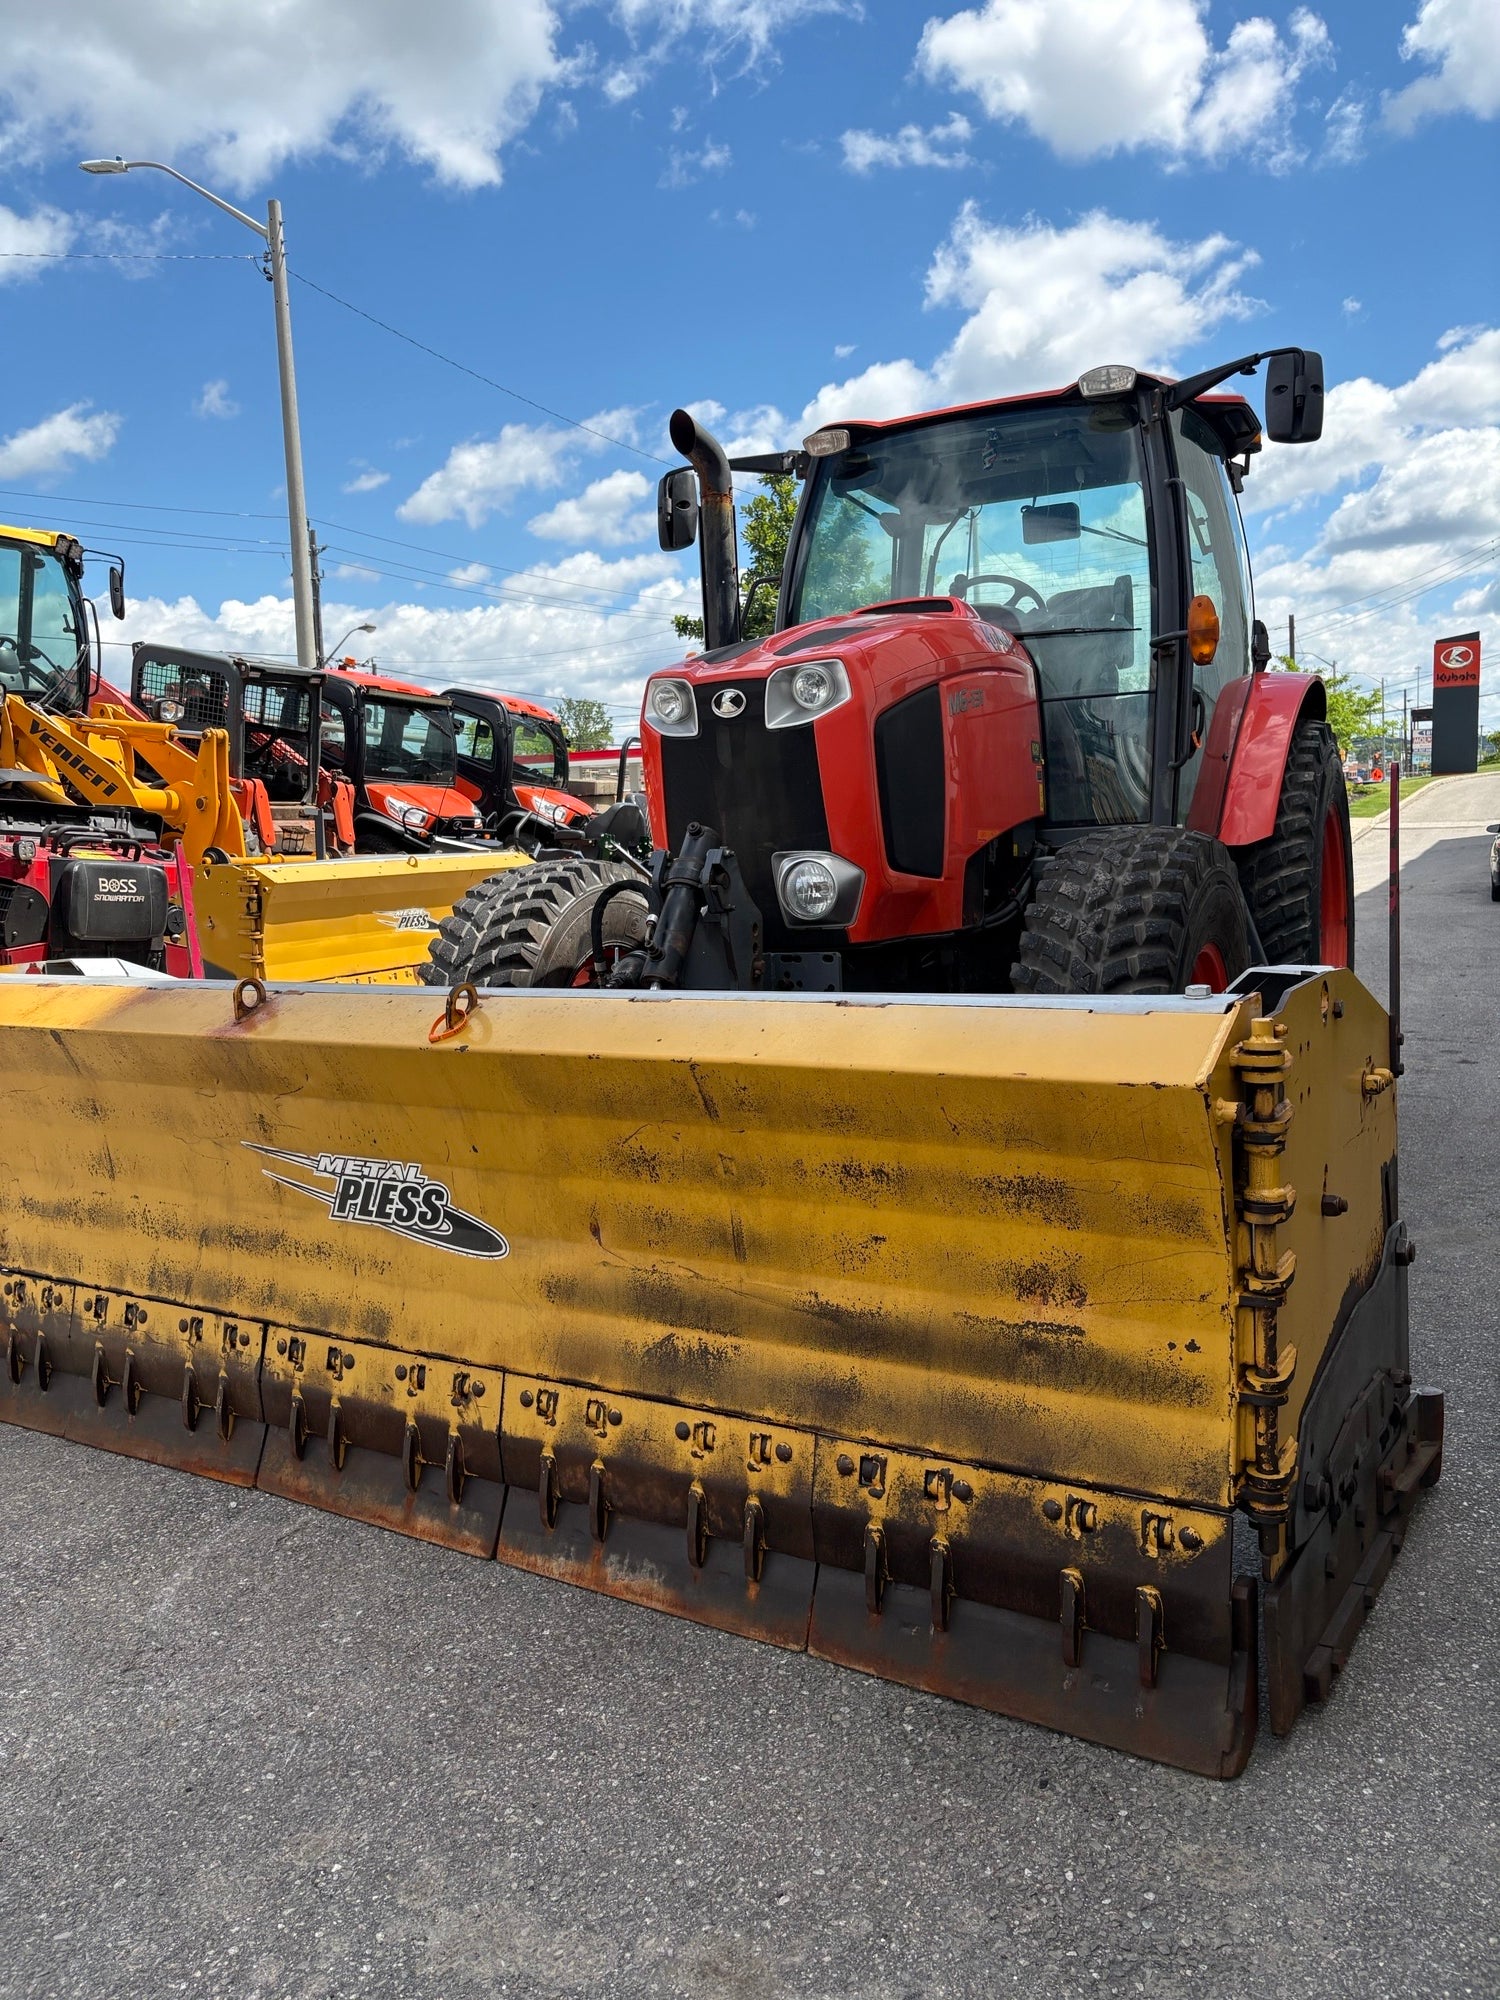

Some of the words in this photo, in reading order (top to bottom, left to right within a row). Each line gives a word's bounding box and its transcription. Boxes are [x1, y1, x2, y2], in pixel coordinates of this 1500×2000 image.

[1436, 671, 1477, 683] Kubota
[98, 877, 138, 894] BOSS
[398, 914, 429, 929] PLESS
[317, 1154, 428, 1185] METAL
[334, 1177, 446, 1228] PLESS
